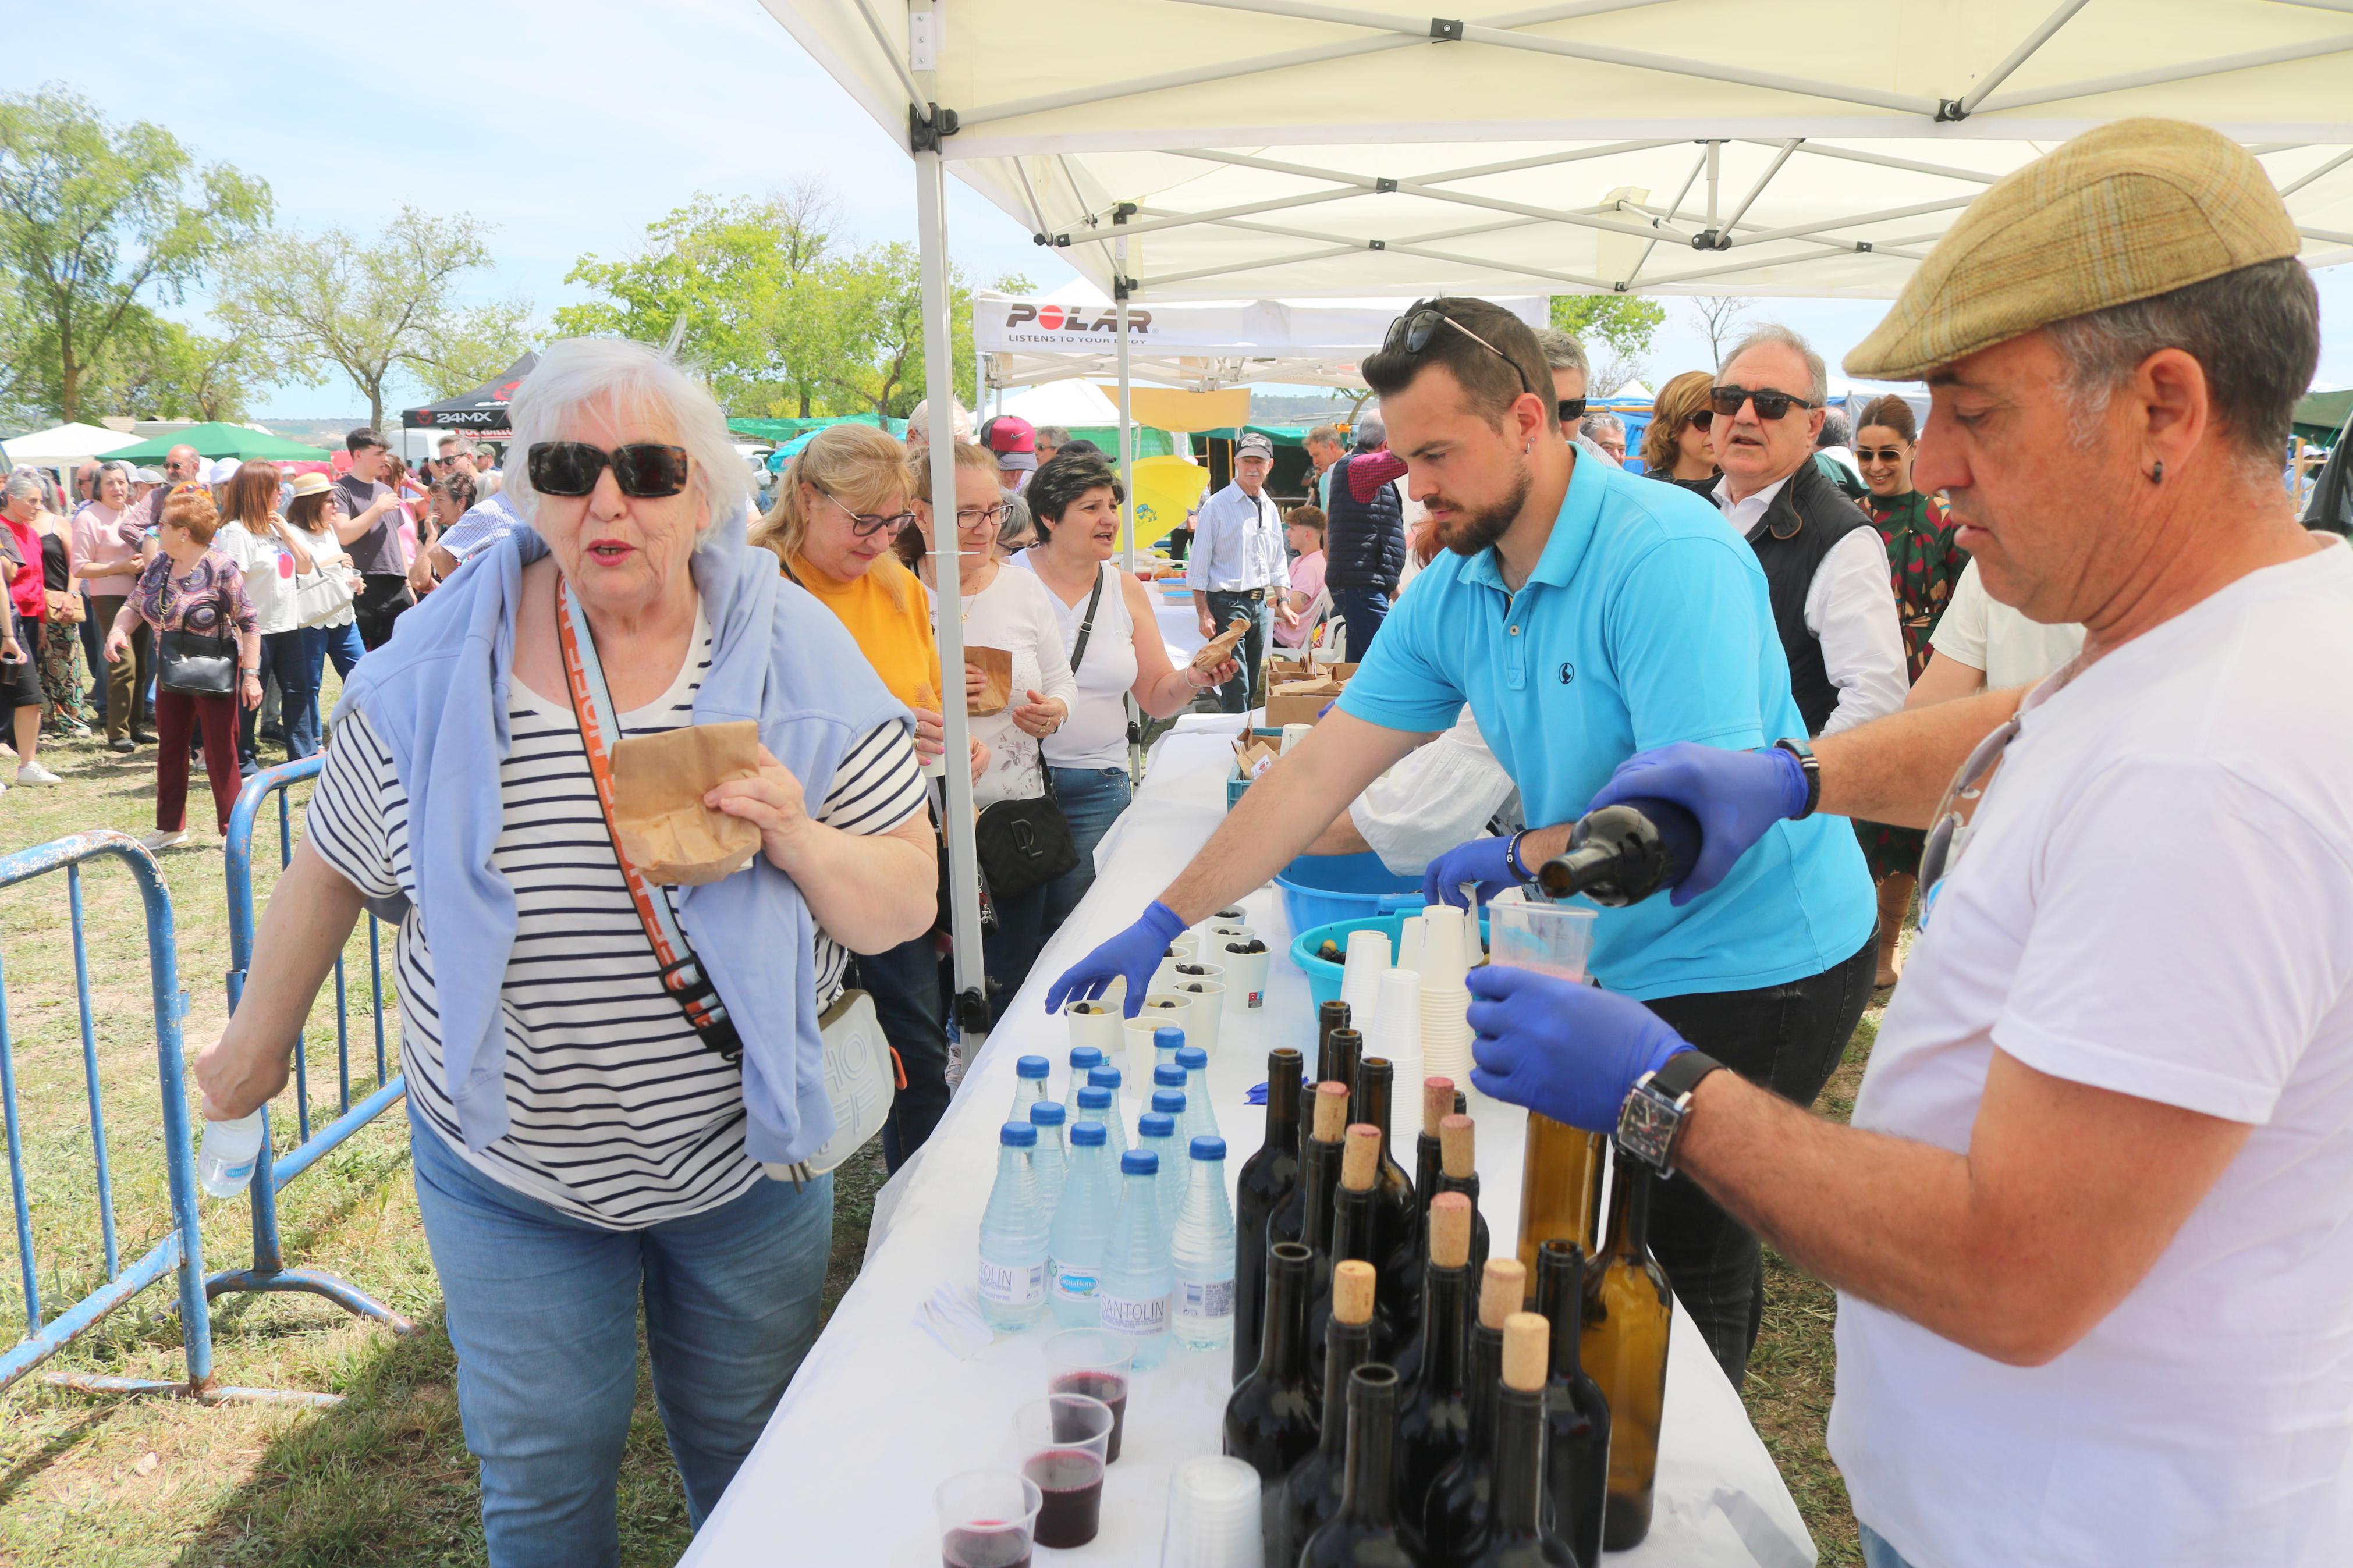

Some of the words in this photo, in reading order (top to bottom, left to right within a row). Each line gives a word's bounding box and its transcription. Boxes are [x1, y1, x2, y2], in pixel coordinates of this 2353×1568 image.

[1006, 304, 1152, 333] POLAR
[436, 411, 492, 423] 24MX
[1102, 1295, 1163, 1320] SANTOLÍN
